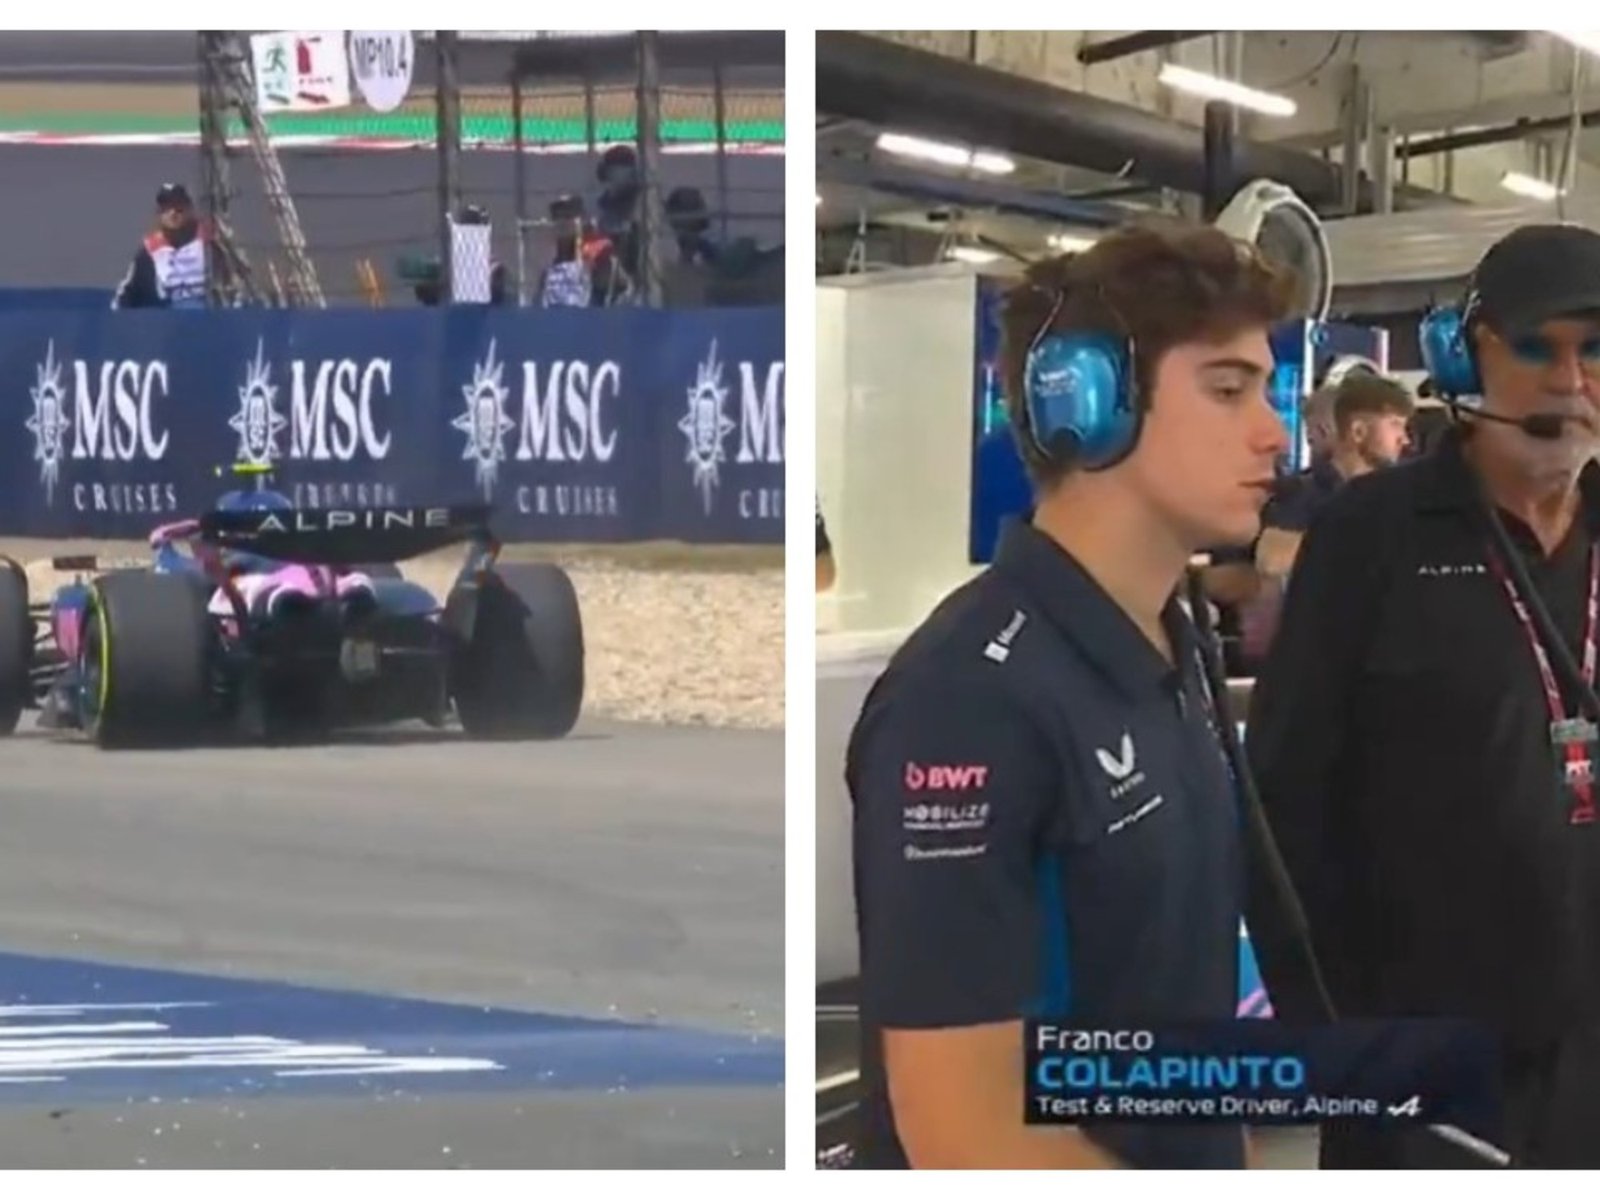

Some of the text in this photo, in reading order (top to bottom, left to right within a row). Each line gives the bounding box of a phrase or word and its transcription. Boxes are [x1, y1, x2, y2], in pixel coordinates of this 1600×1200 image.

[72, 360, 169, 460] MSC
[290, 358, 392, 460] MSC
[516, 360, 620, 460] MSC
[736, 361, 785, 464] M
[73, 482, 177, 512] CRUISES
[257, 508, 449, 533] ALPINE
[926, 765, 988, 789] BWT
